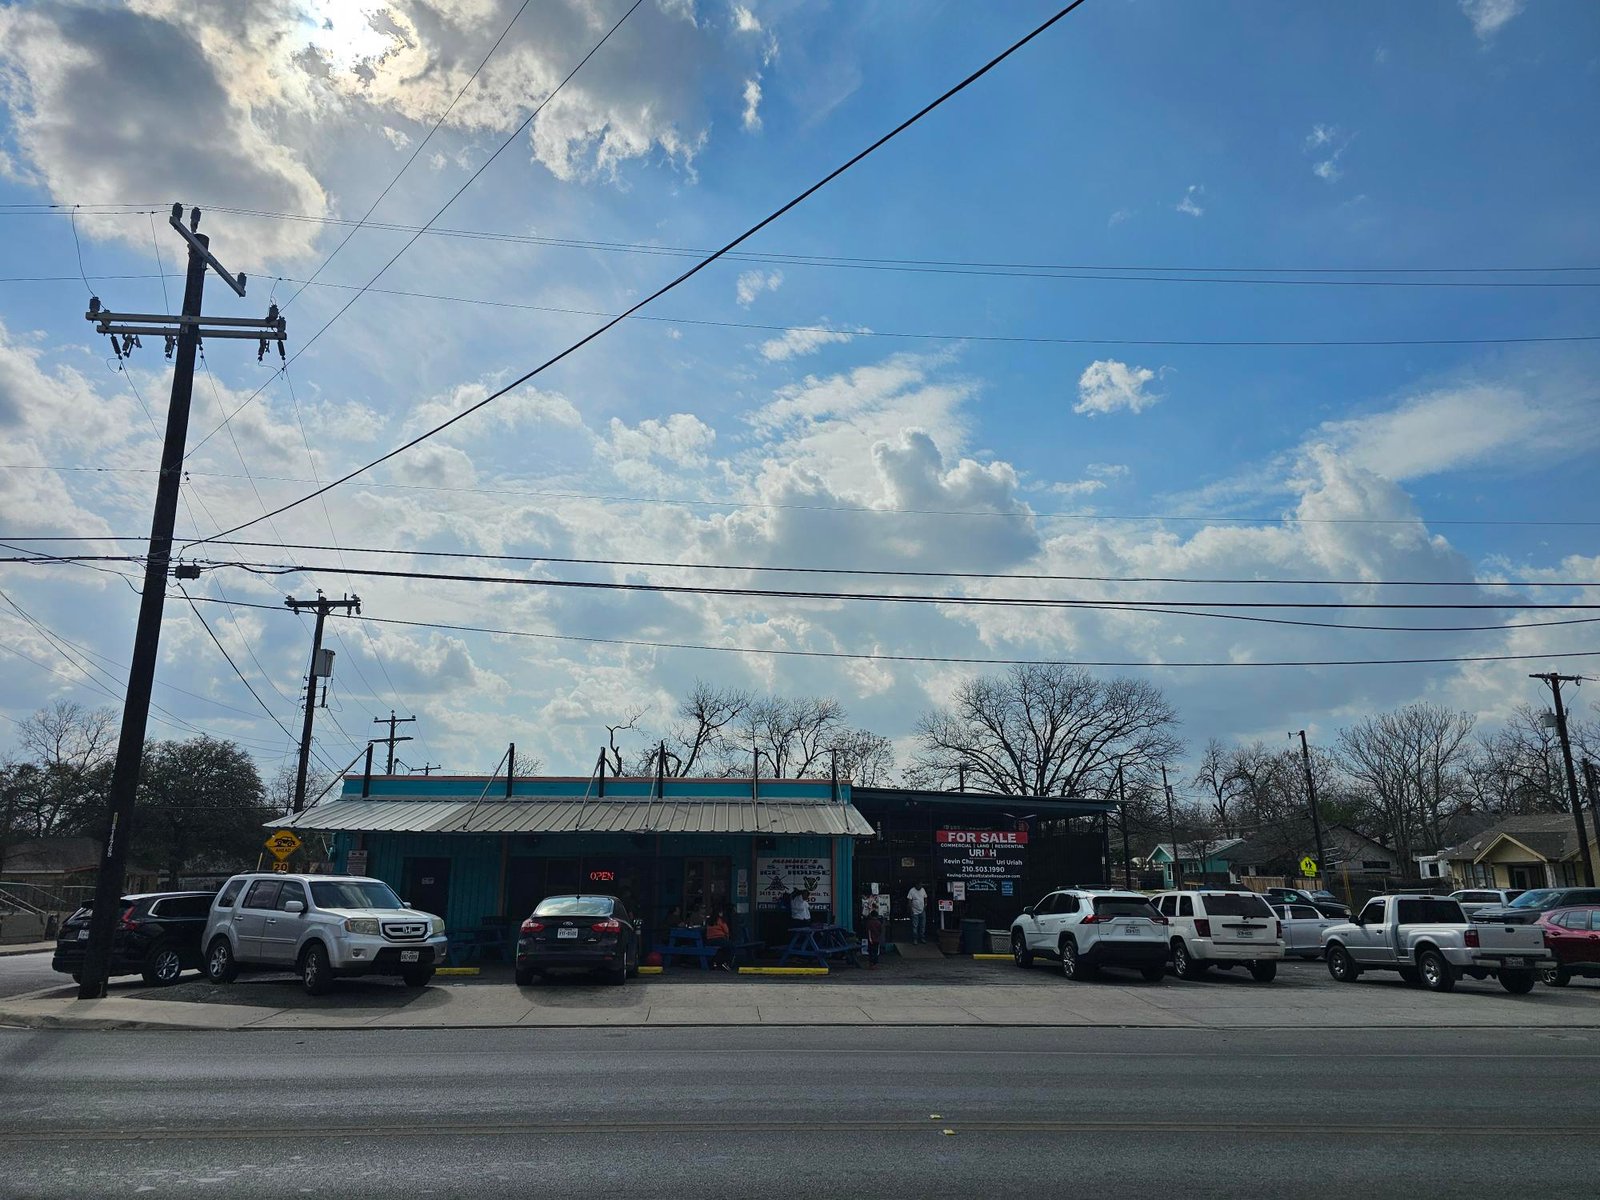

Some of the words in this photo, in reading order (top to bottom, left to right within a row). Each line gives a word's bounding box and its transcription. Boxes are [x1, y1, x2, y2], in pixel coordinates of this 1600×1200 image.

[948, 832, 976, 843] FOR
[980, 832, 1016, 843] SALE
[969, 849, 996, 857] URIAH
[590, 872, 614, 880] OPEN
